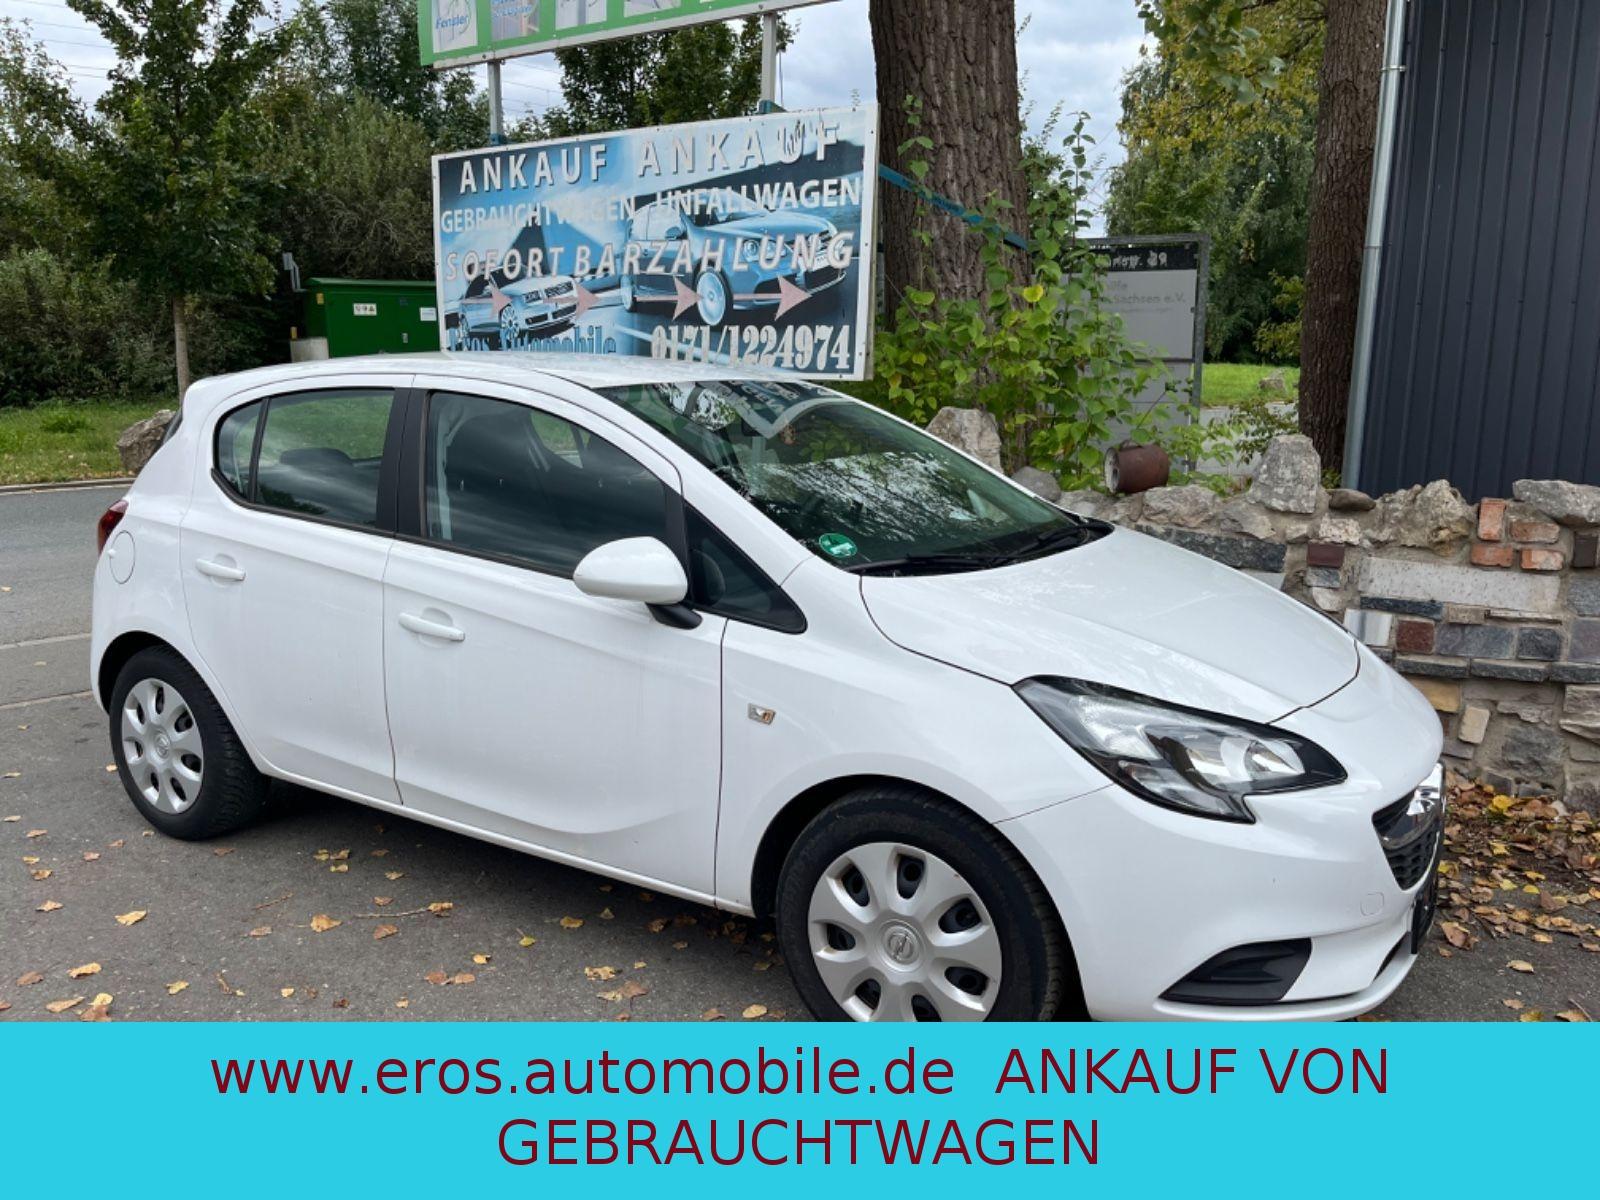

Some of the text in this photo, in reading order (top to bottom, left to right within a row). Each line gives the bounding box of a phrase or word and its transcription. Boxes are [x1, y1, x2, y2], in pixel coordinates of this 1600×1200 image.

[459, 120, 841, 195] ANKAUF ANKAUF
[441, 175, 861, 234] GEBRAUCHTWAGEN UNFALLWAGEN
[446, 231, 855, 283] SOFORT BARZAHLUNG
[651, 324, 851, 371] 0171/1224974
